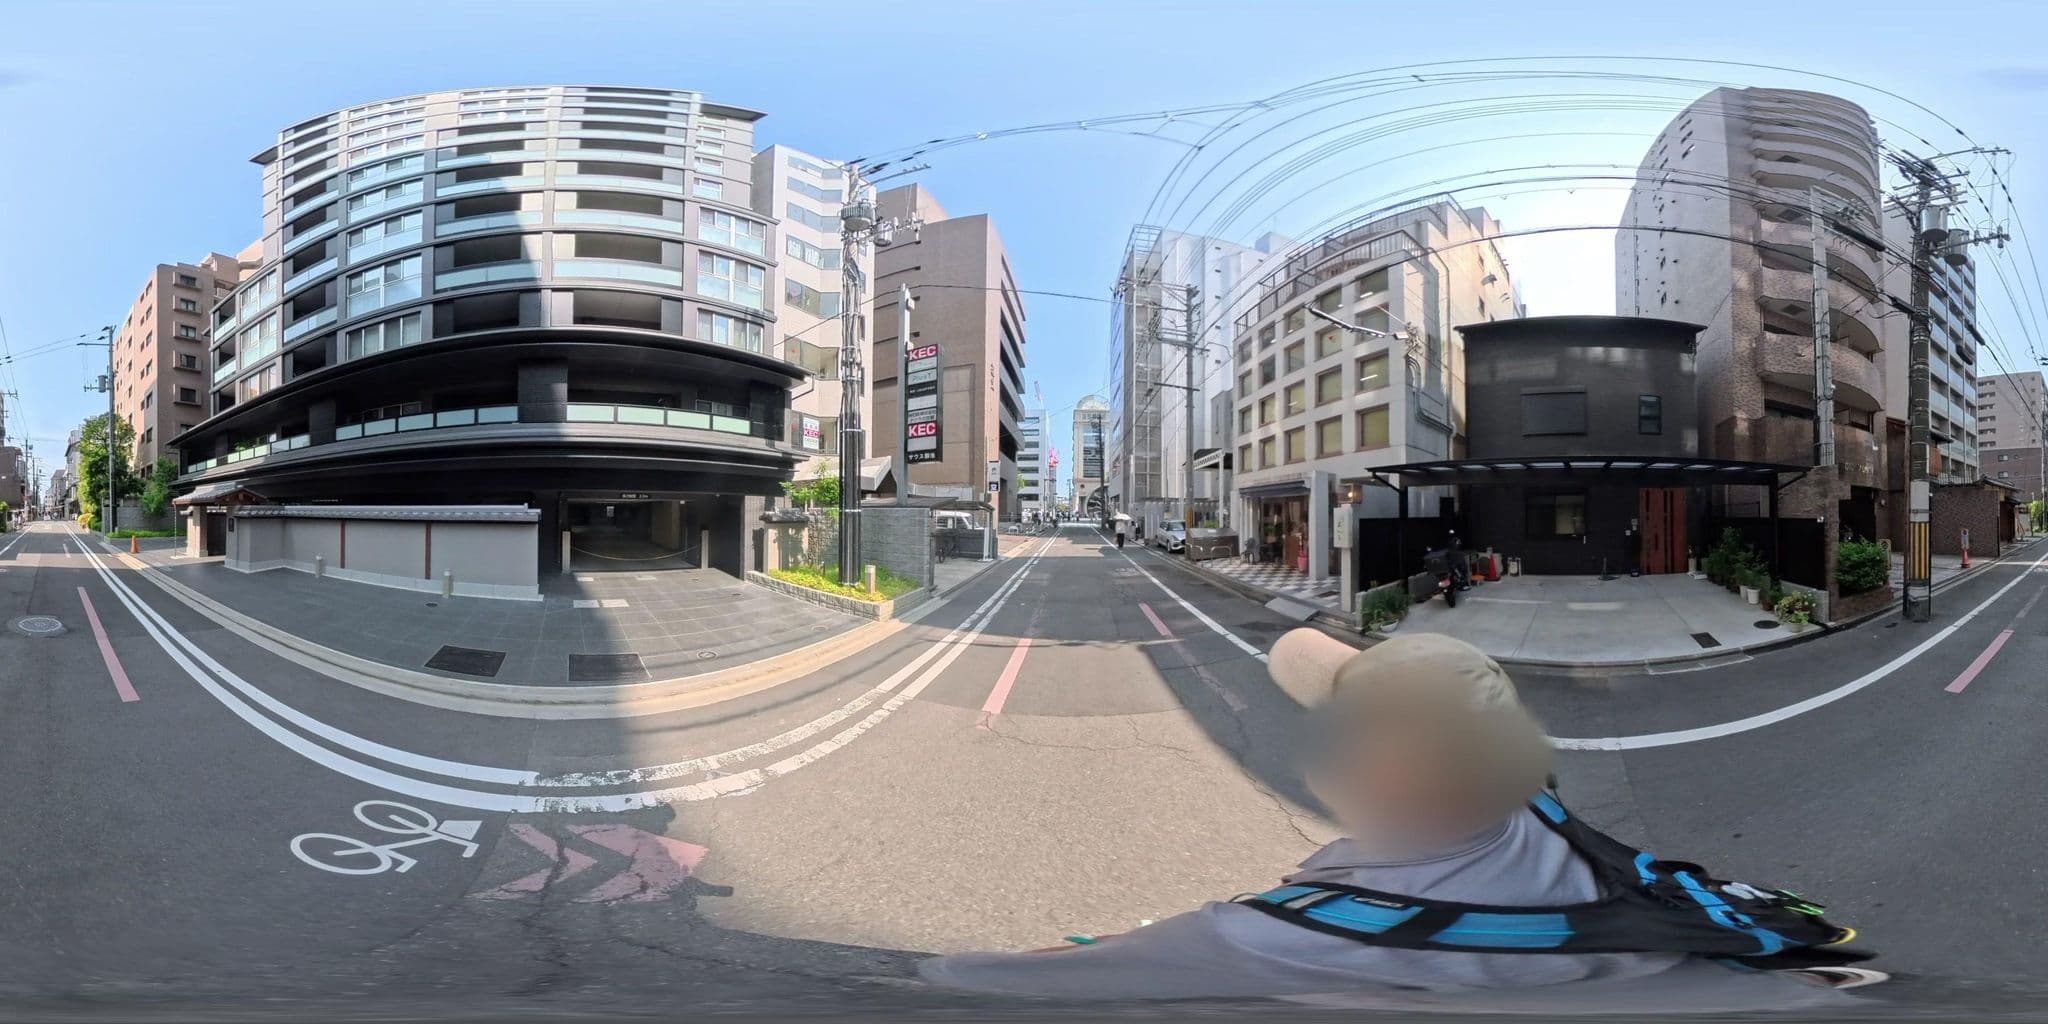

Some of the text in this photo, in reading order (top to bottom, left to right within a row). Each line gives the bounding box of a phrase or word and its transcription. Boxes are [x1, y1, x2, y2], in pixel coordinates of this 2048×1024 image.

[909, 345, 937, 361] KEC
[804, 429, 821, 438] KEC
[908, 422, 936, 437] KEC
